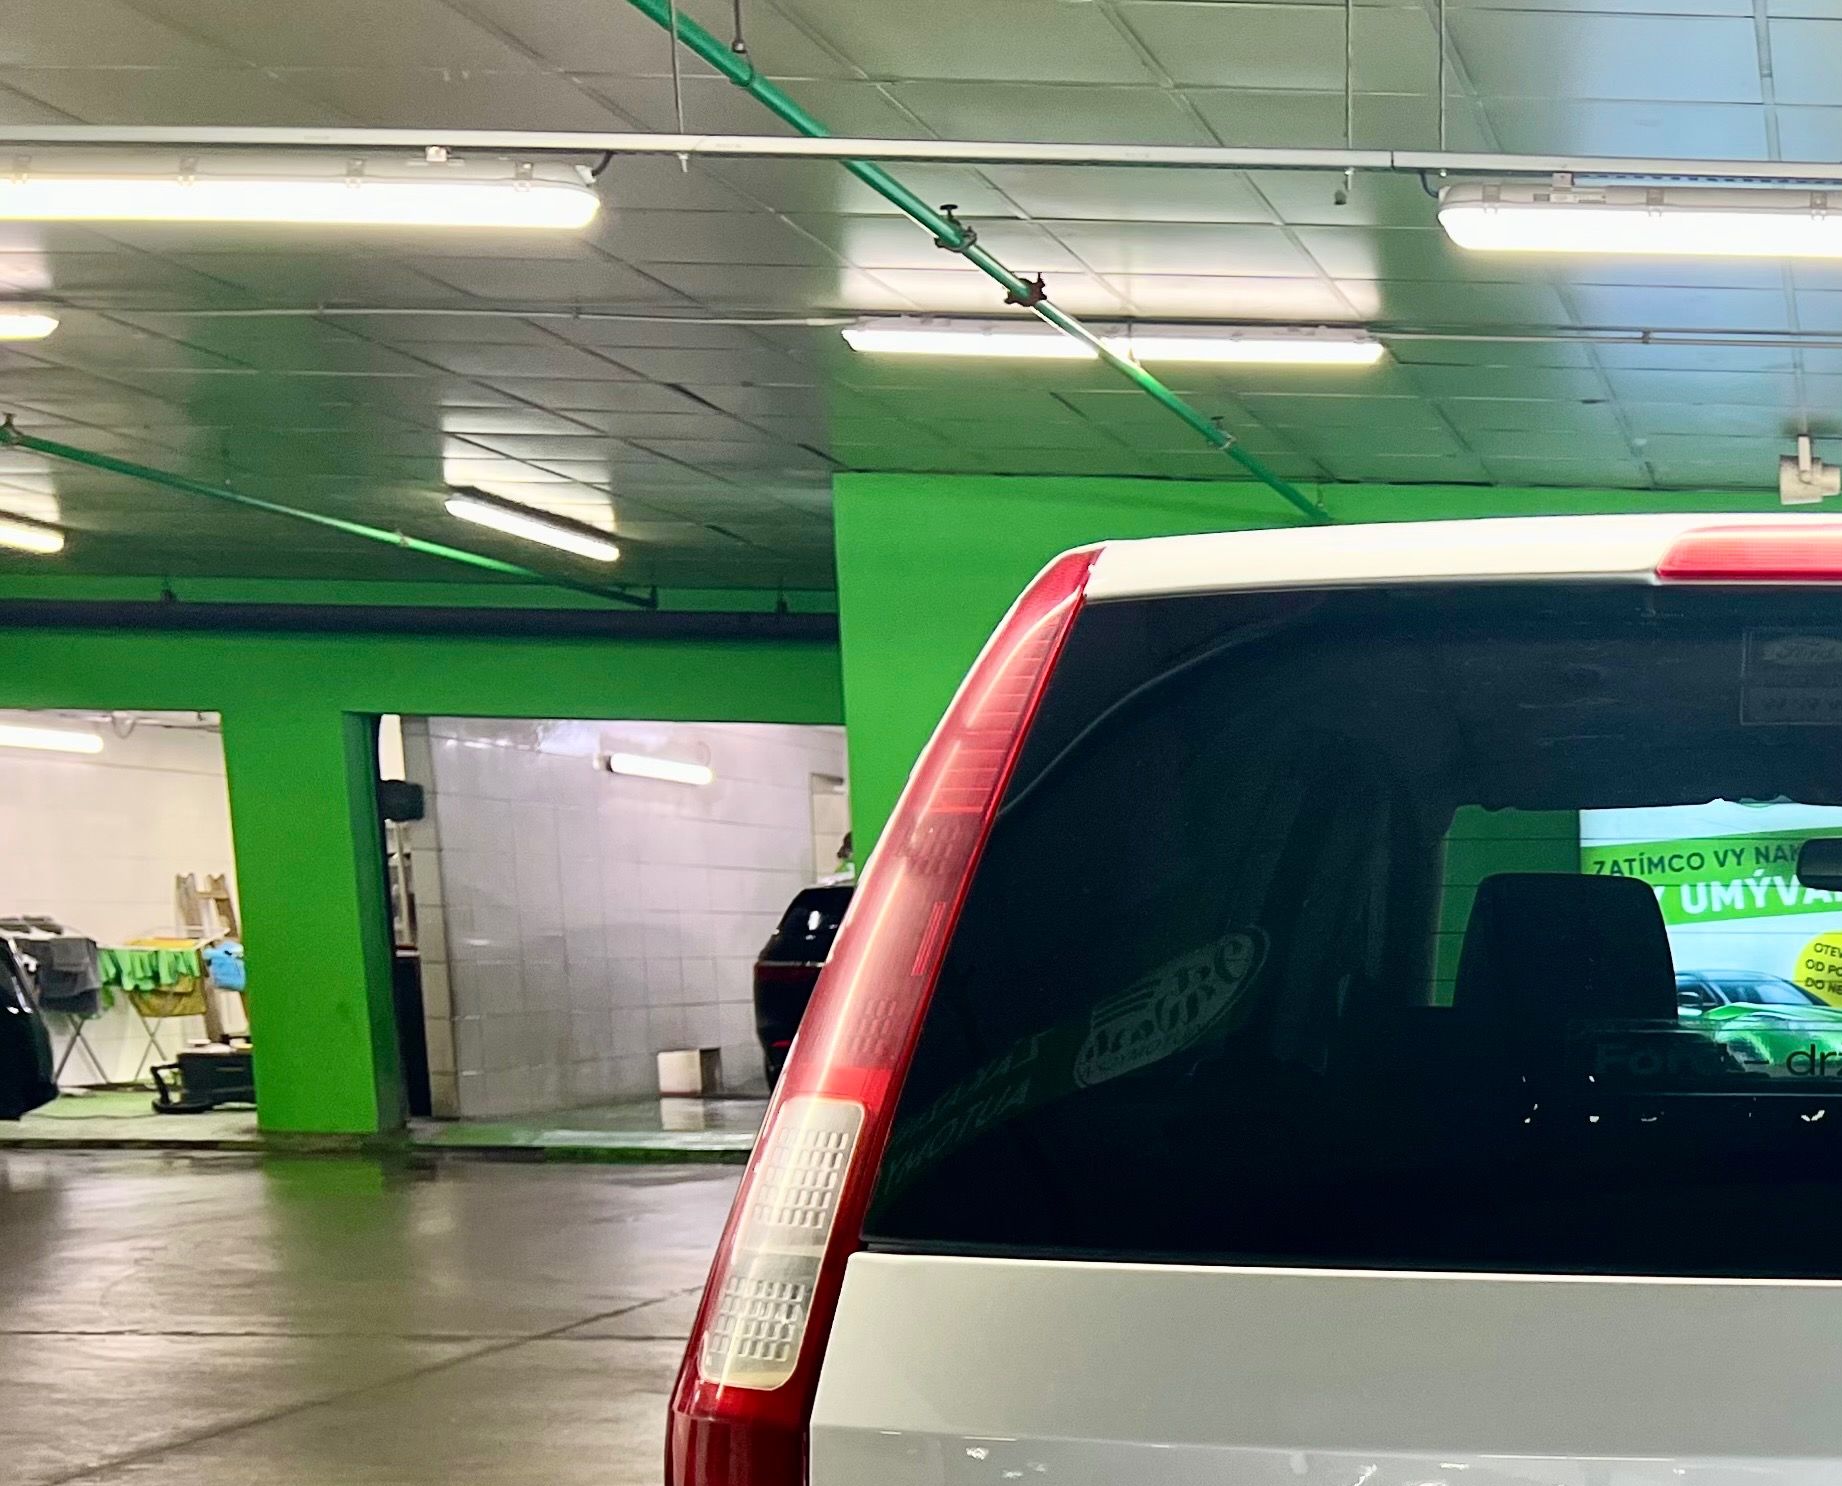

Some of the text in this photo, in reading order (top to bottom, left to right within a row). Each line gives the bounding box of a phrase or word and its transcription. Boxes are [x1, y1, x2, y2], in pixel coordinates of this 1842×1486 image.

[1593, 852, 1705, 875] ZATÍMCO
[1714, 848, 1745, 868] VY
[1805, 959, 1825, 972] OD
[1805, 977, 1825, 990] DO
